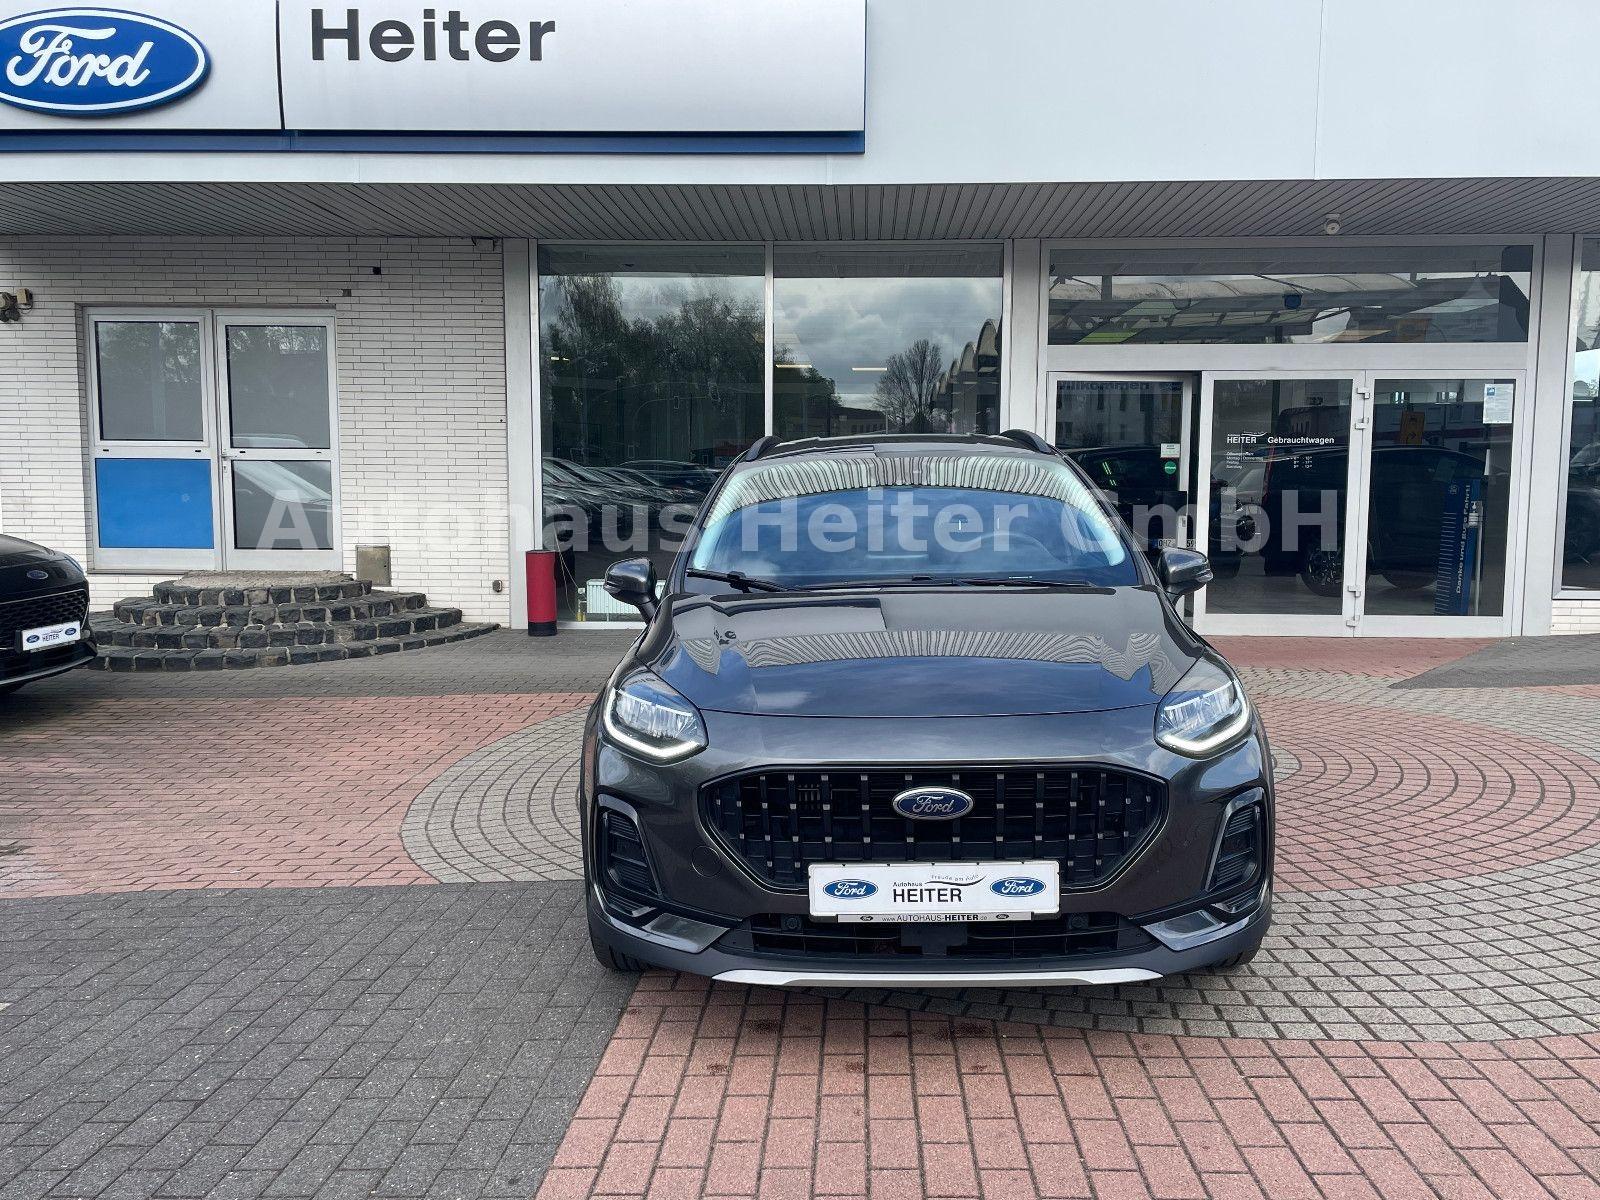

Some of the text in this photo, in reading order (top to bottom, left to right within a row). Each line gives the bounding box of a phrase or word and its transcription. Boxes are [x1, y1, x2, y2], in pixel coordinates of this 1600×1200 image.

[311, 8, 556, 62] Heiter
[5, 24, 154, 89] Ford
[1226, 436, 1335, 445] HEITER Gebrauchtwagen
[1456, 562, 1464, 594] Danke
[42, 634, 60, 642] HEITER
[912, 794, 955, 814] Ford
[834, 881, 868, 896] Ford
[1001, 879, 1035, 894] Ford
[893, 888, 963, 903] HEITER
